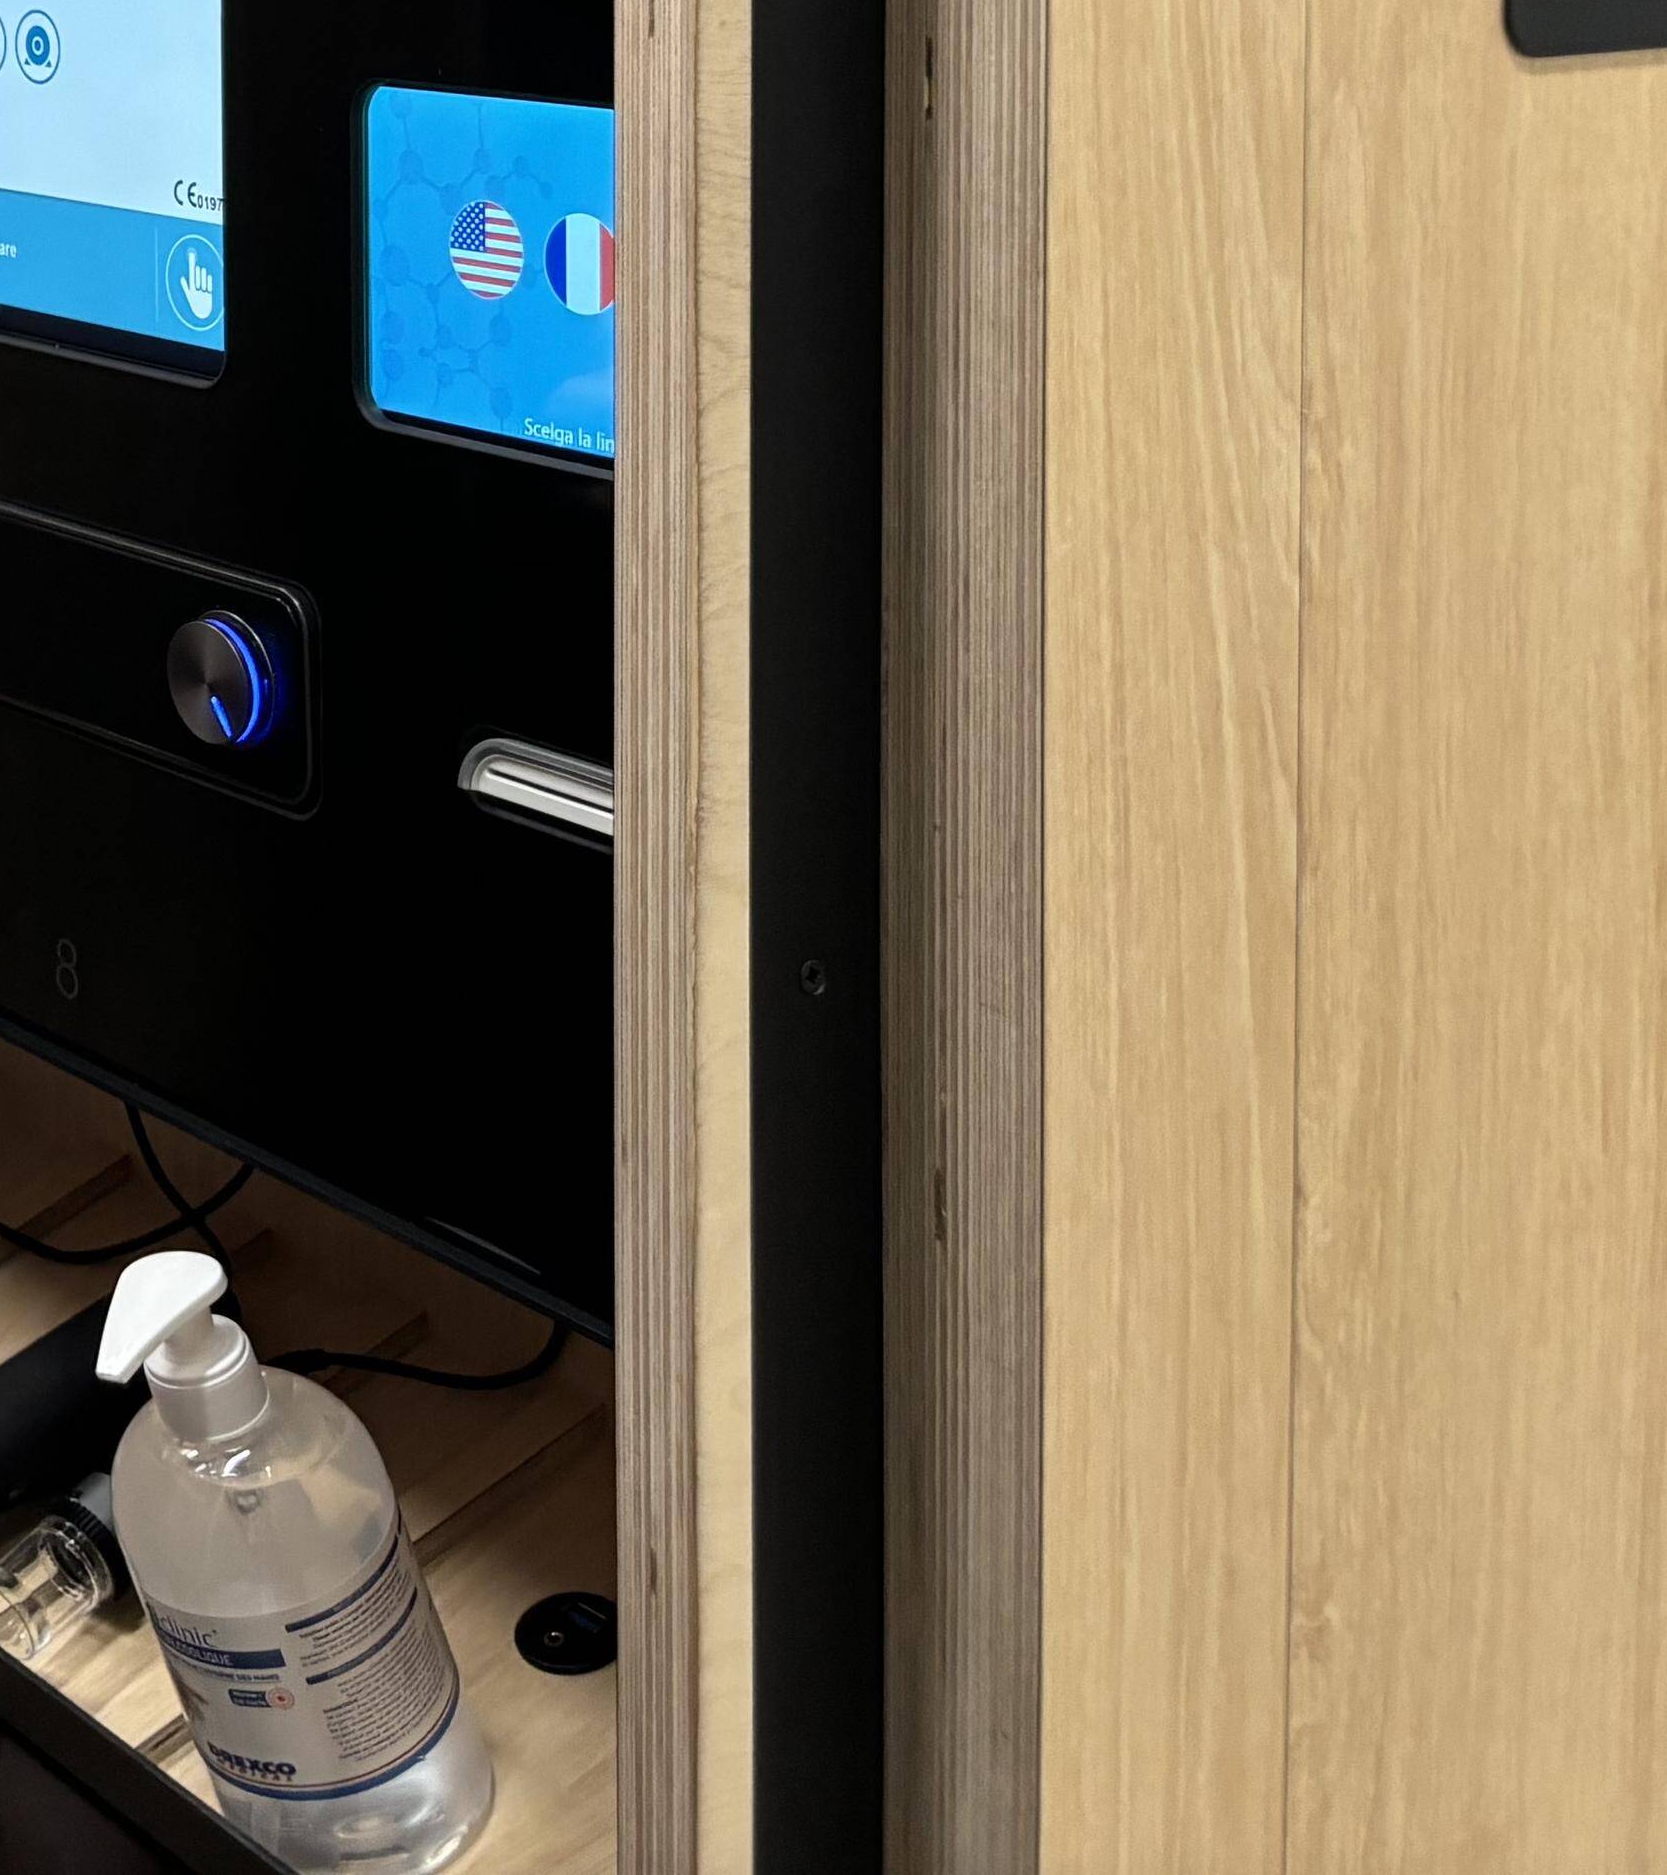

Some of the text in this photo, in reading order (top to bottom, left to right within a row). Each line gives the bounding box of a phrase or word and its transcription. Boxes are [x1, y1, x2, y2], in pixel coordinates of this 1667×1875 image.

[524, 417, 615, 455] Scelga la lin
[54, 937, 80, 1001] 8
